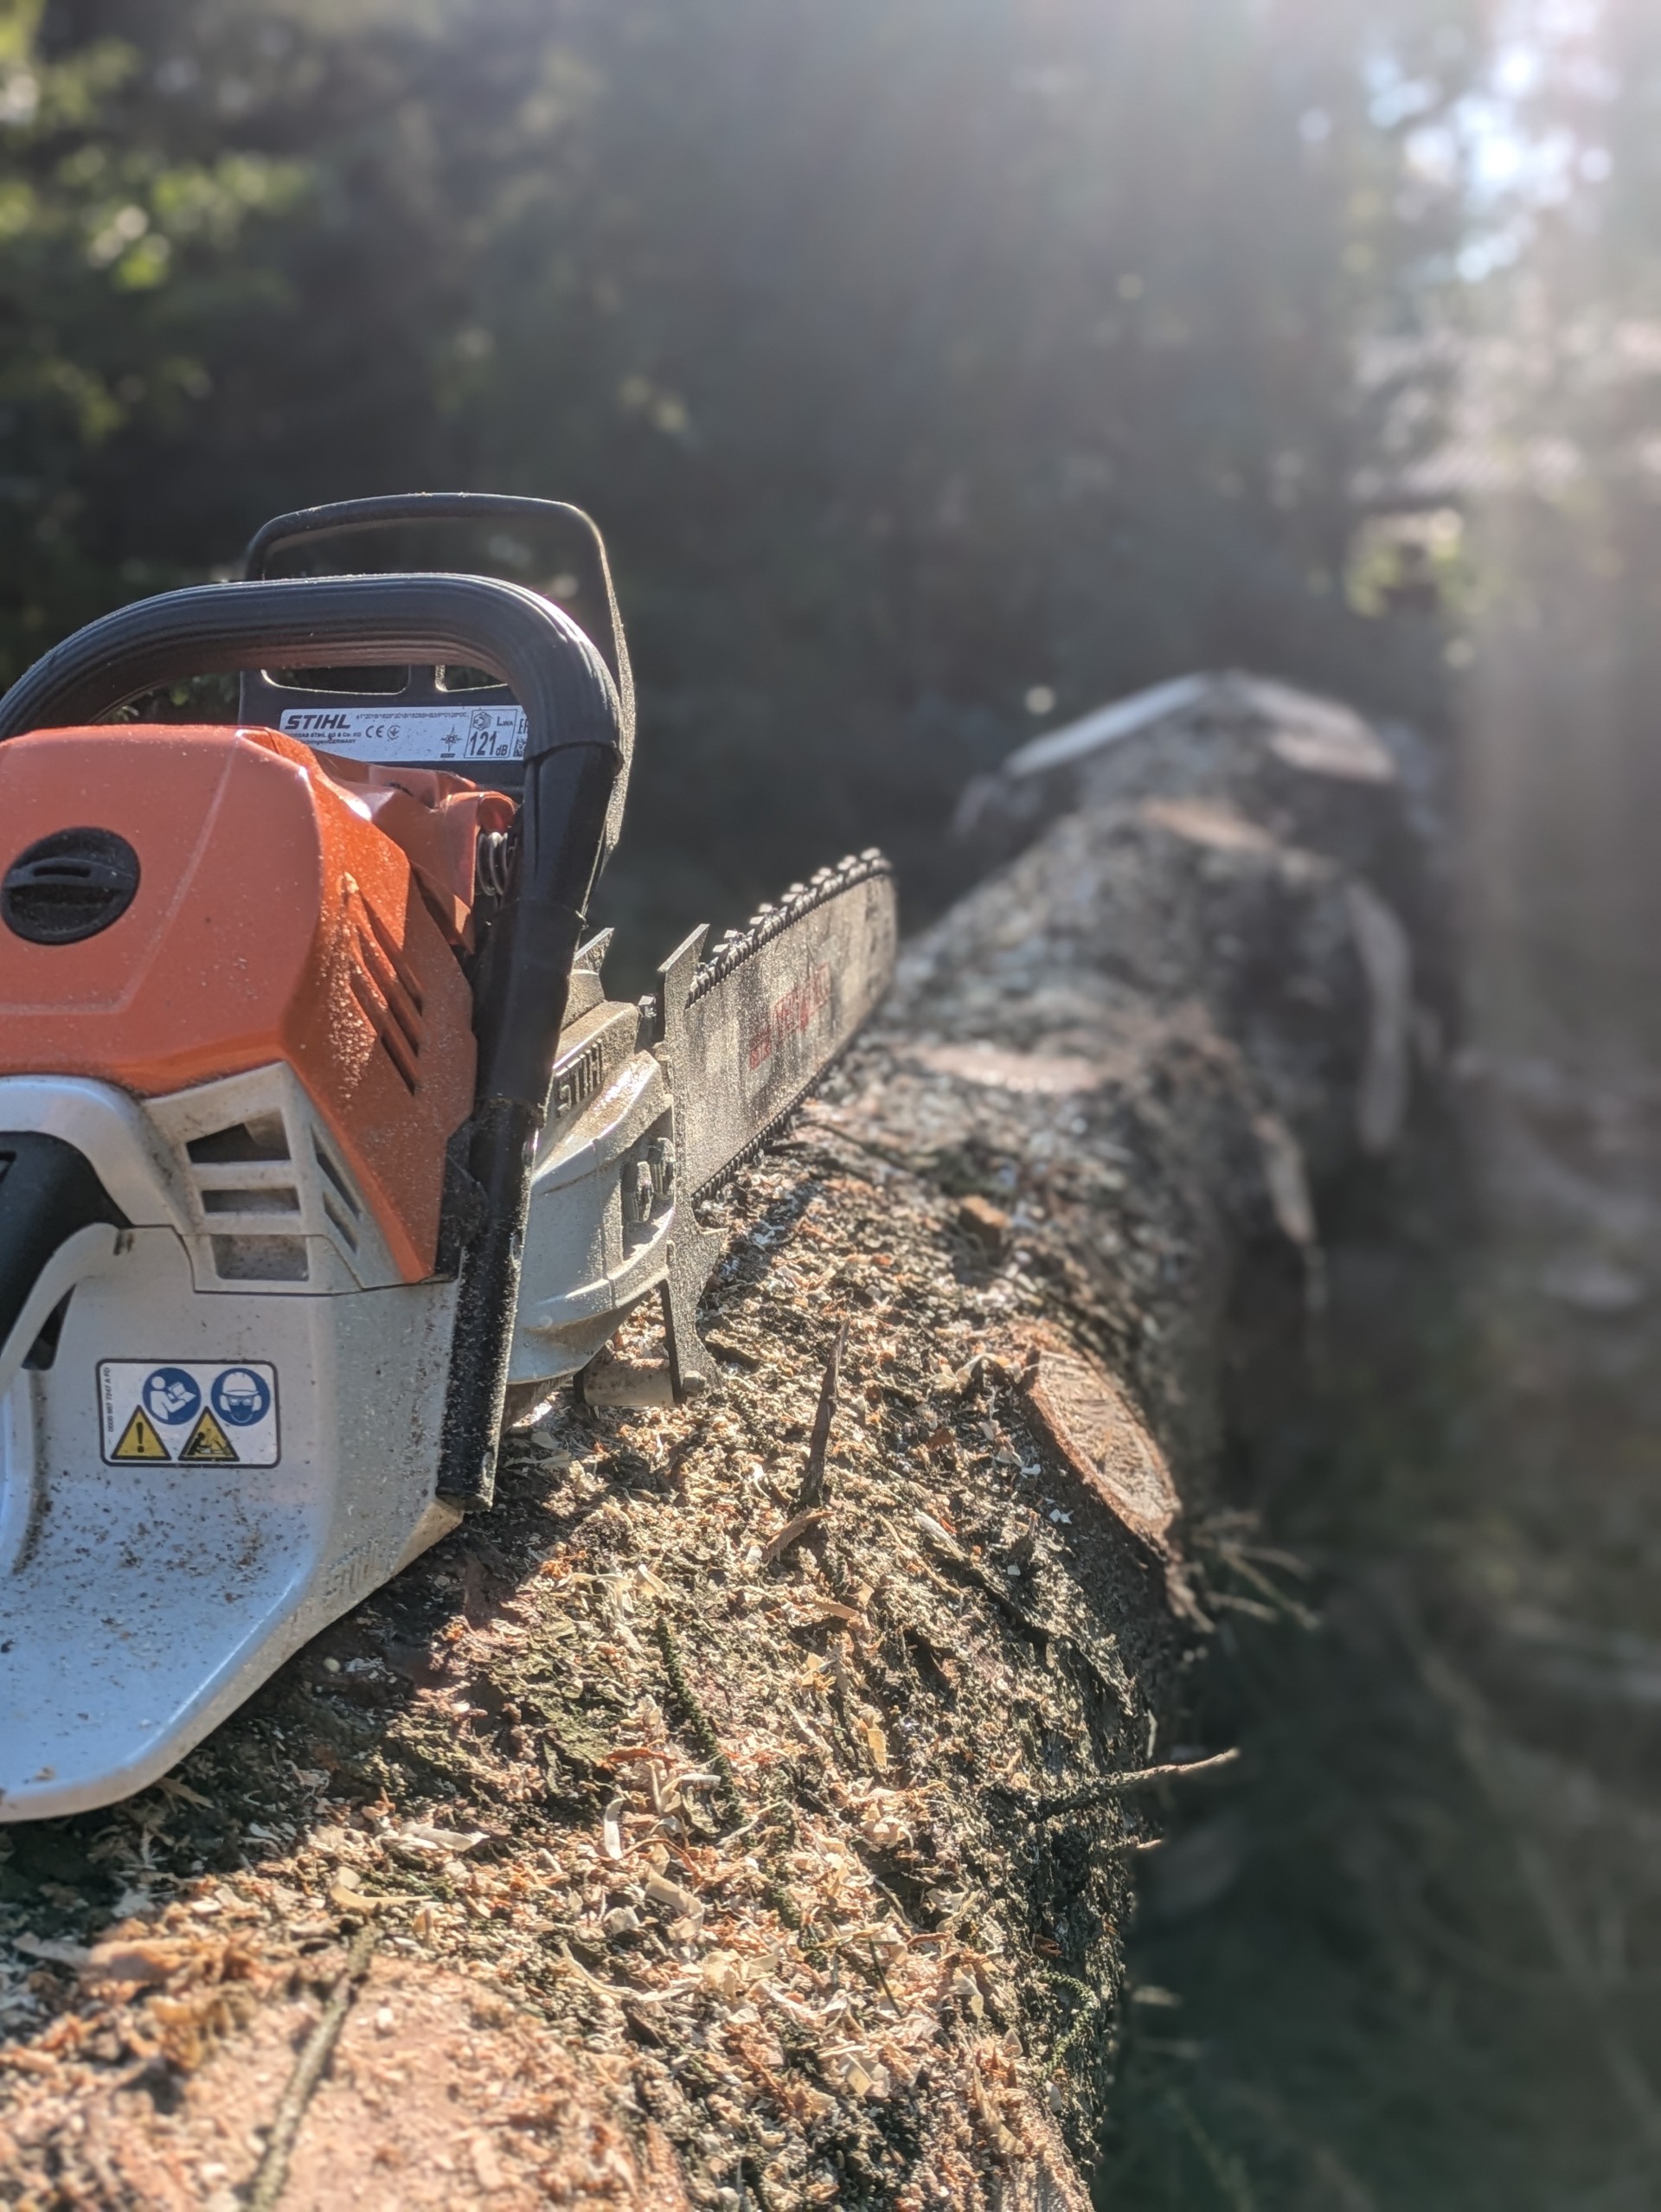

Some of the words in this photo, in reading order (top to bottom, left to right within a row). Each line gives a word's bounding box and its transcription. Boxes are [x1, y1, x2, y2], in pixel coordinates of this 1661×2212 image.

[284, 714, 351, 729] STIHL
[470, 731, 497, 756] 121
[496, 745, 509, 756] dB
